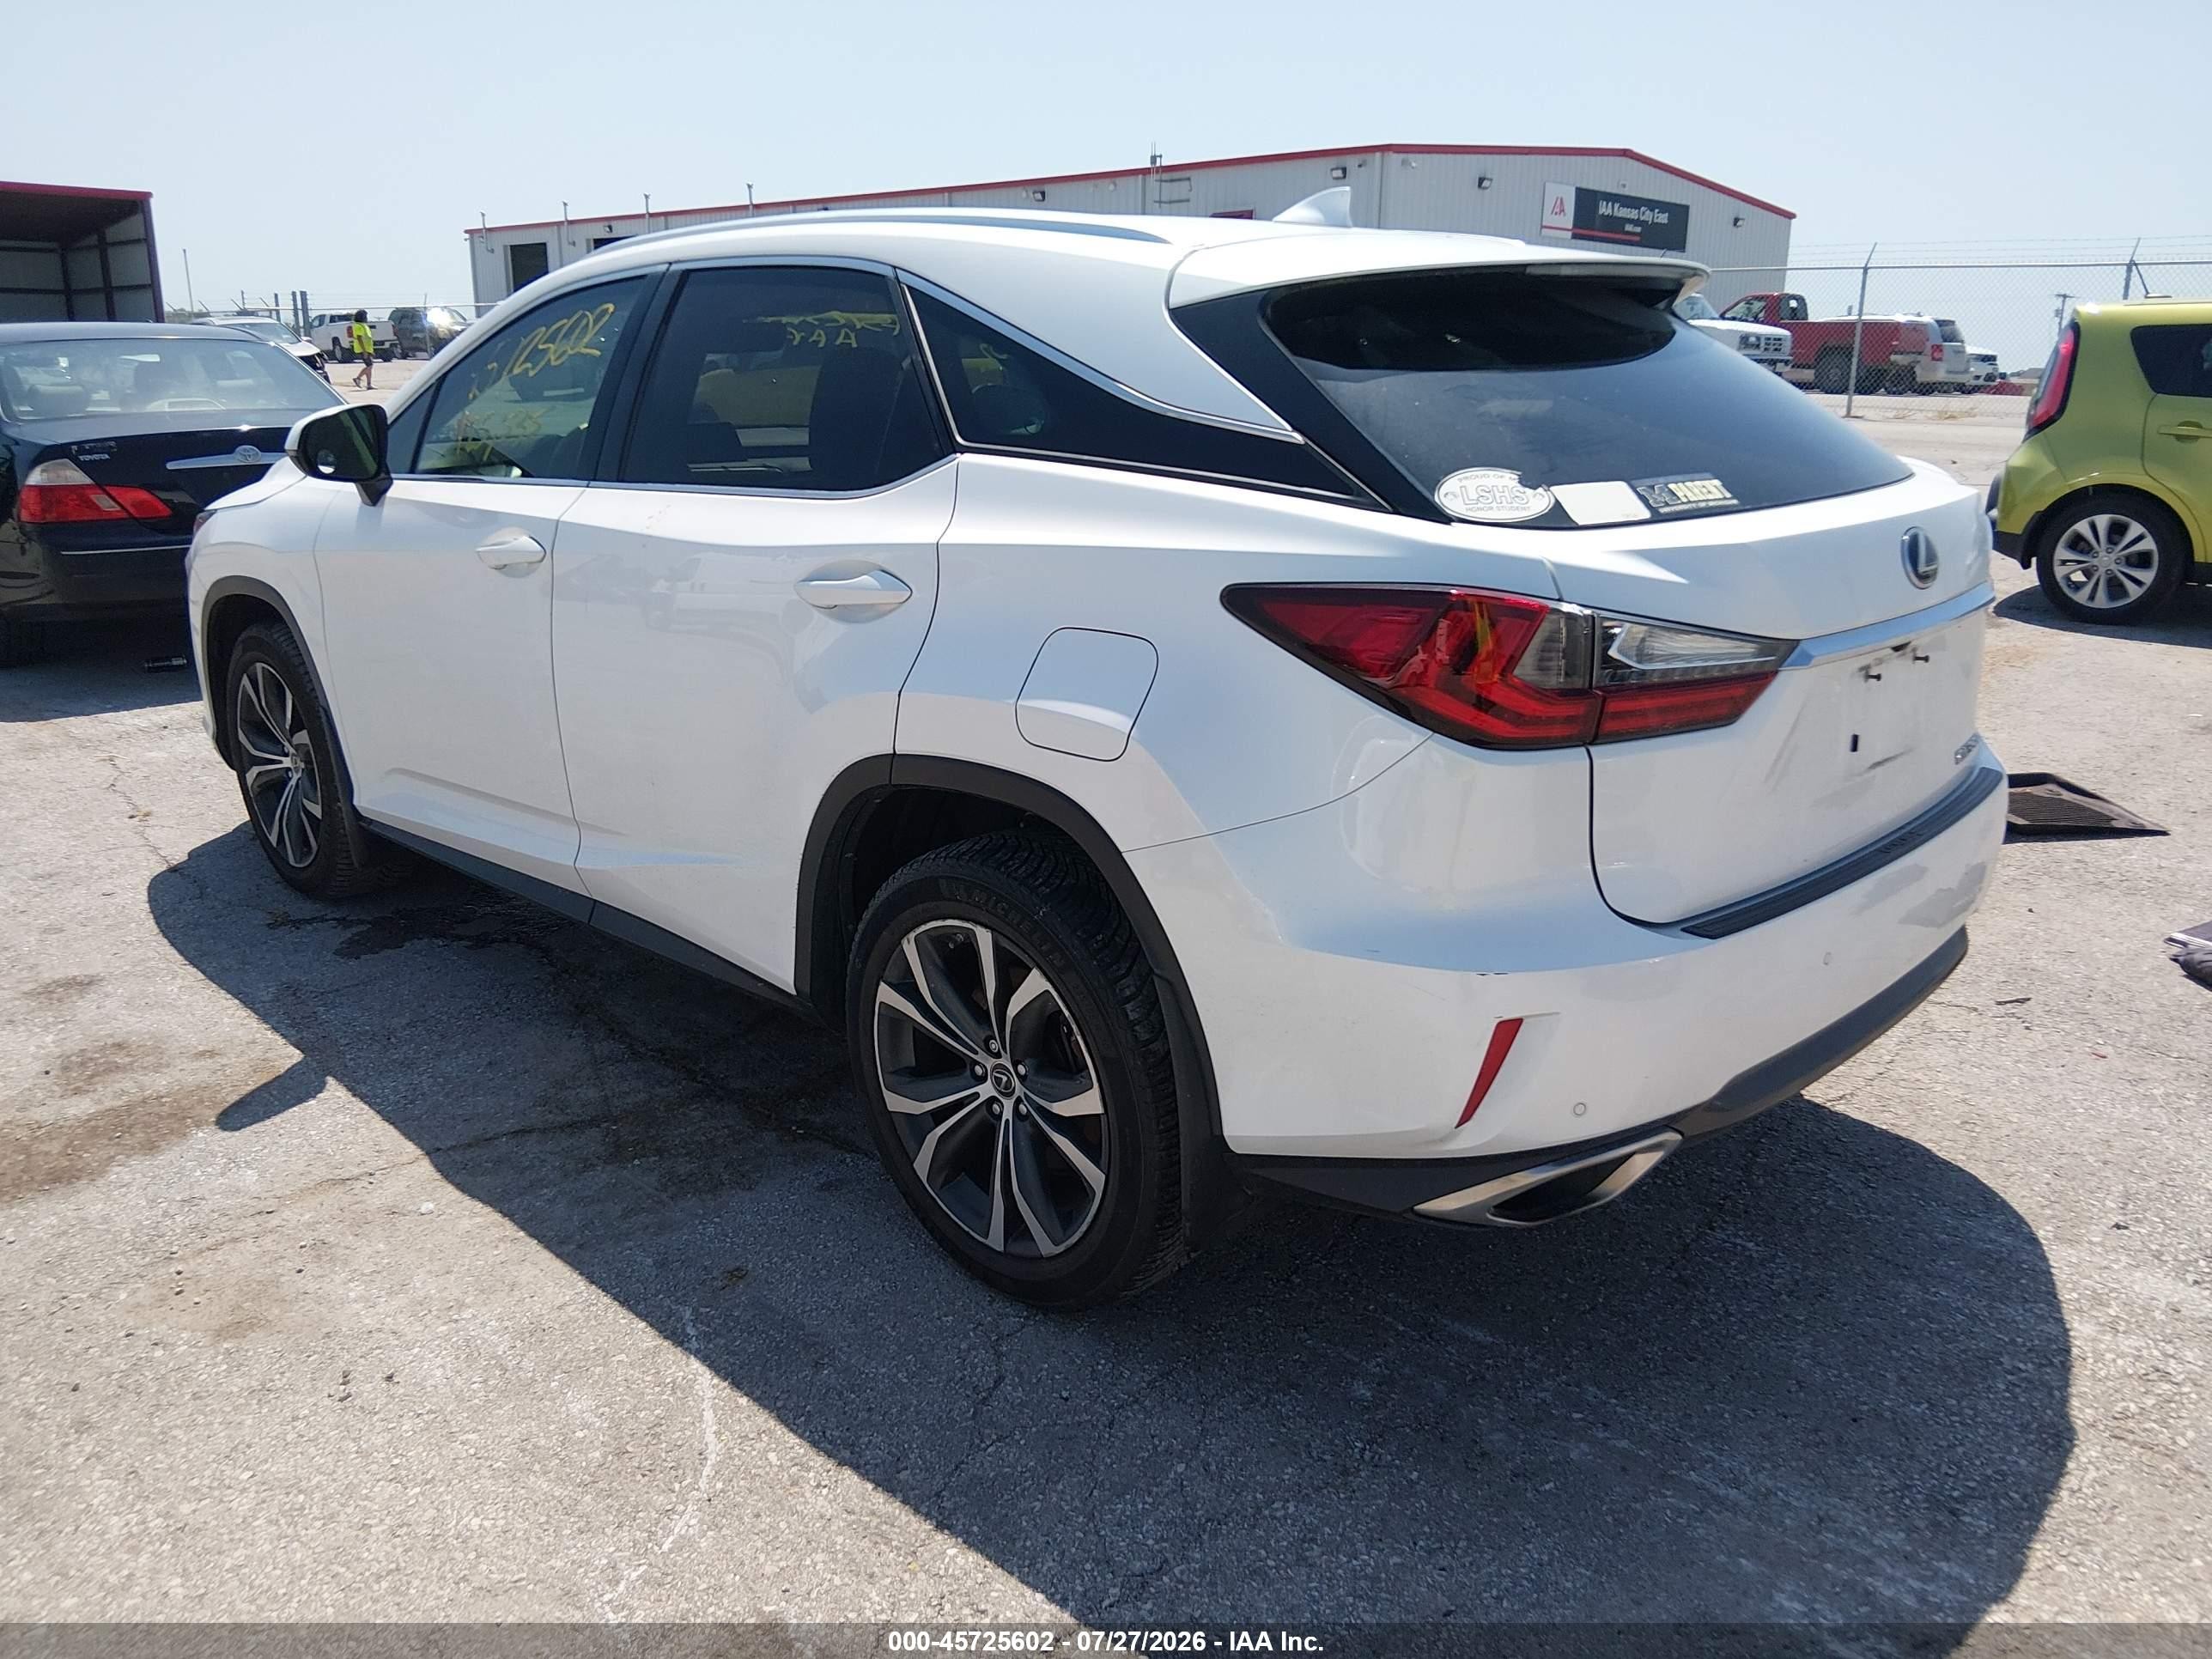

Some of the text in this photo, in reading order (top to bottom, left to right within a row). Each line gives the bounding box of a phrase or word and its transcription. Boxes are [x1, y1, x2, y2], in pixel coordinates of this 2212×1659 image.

[1598, 200, 1668, 225] IAA Kansas City East
[1457, 473, 1491, 482] PROUD
[1460, 484, 1530, 506] LSHS
